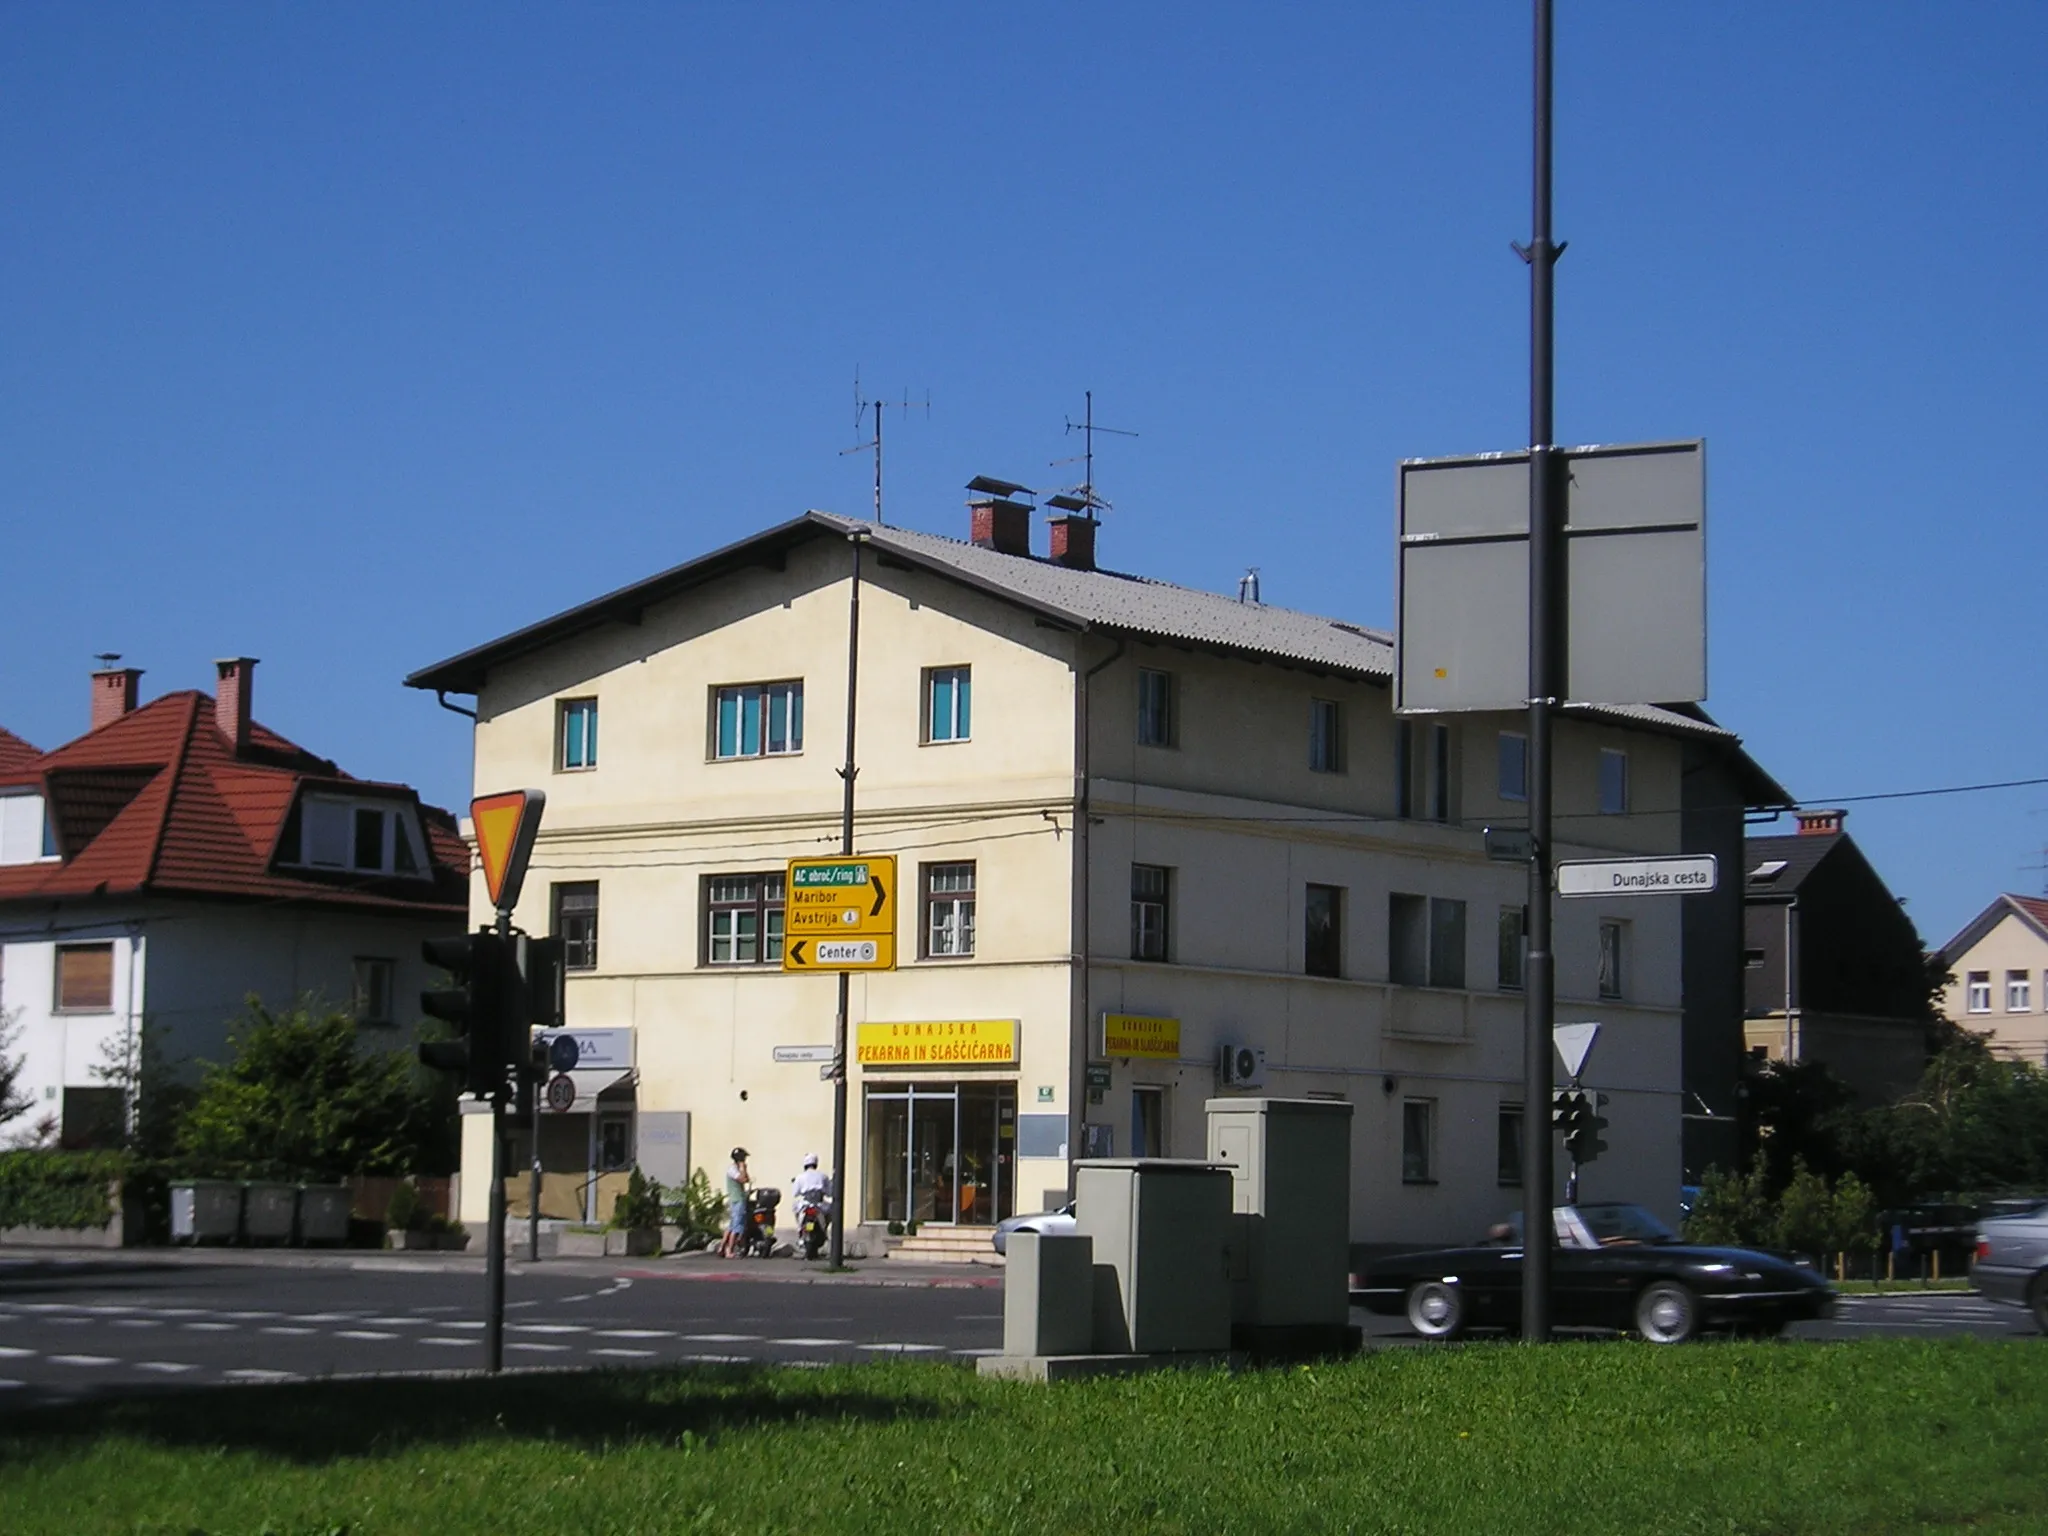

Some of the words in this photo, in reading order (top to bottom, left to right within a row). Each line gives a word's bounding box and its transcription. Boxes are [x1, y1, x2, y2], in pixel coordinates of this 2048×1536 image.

[795, 869, 806, 882] AC
[1613, 873, 1669, 888] Dunajska
[1674, 871, 1706, 884] cesta
[794, 891, 837, 903] Maribor
[794, 911, 838, 926] Avstrija
[819, 945, 857, 958] Center
[892, 1023, 977, 1036] DUNAJSKA
[858, 1044, 910, 1061] PEKARNA
[914, 1044, 926, 1060] IN
